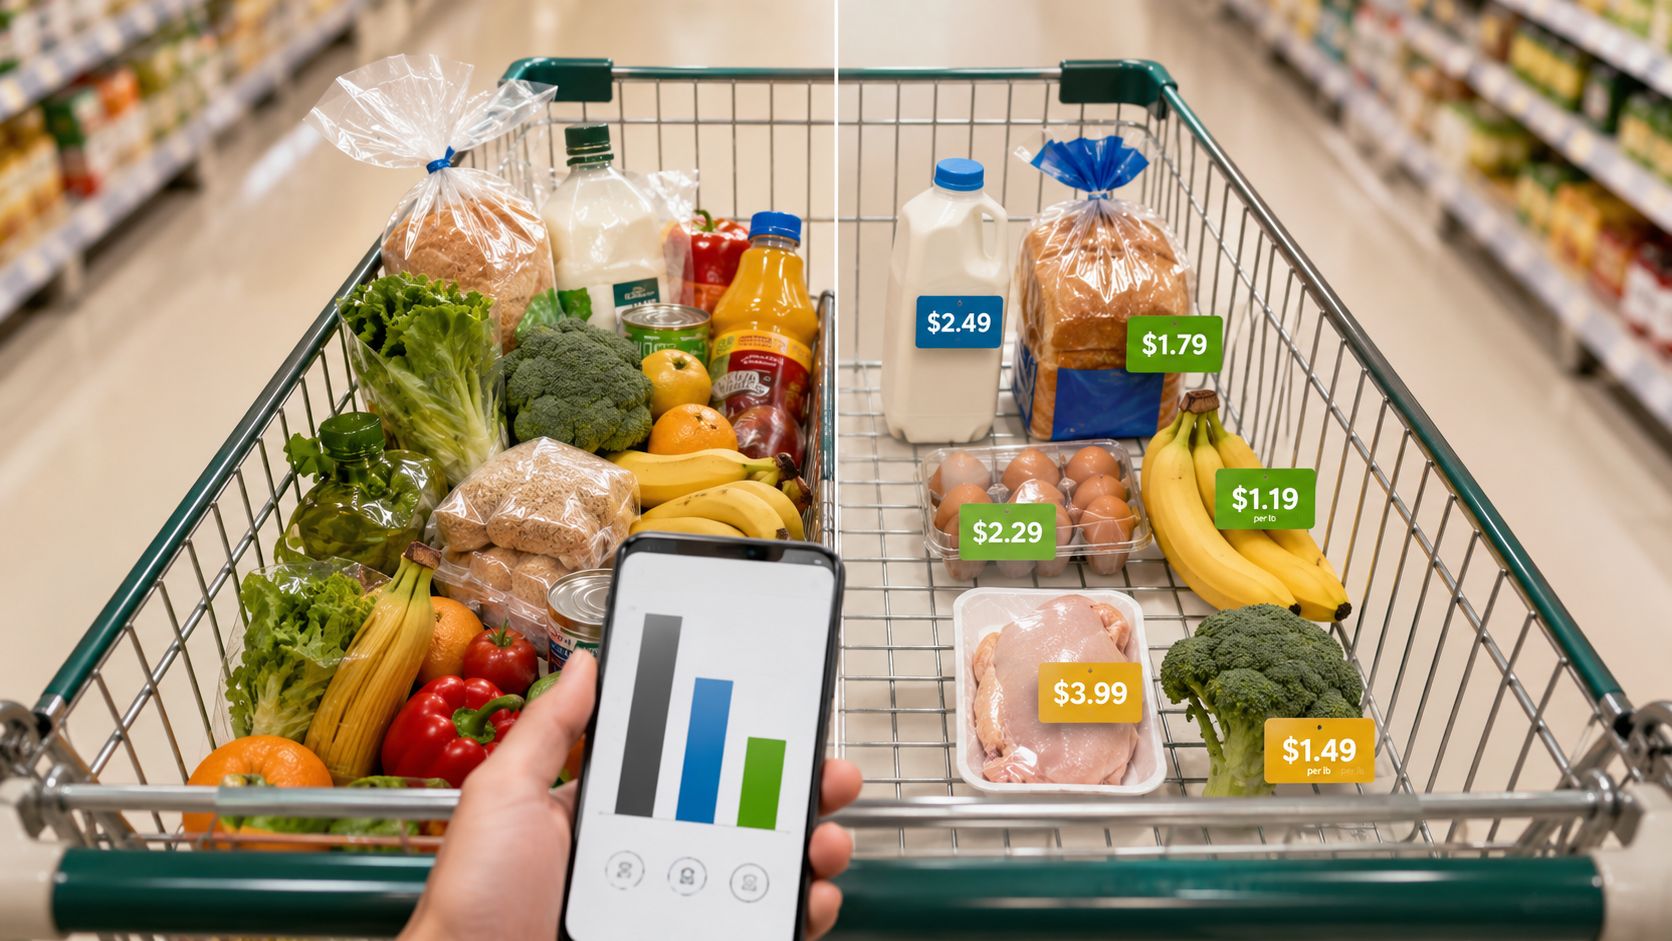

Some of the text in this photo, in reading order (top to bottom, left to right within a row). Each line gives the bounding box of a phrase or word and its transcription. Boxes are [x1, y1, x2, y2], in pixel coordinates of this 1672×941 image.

[927, 310, 991, 335] $2.49
[1142, 331, 1207, 357] $1.79
[1232, 484, 1299, 513] $1.19
[1253, 515, 1268, 524] per
[973, 520, 1043, 545] $2.29
[1054, 679, 1128, 706] $3.99
[1283, 735, 1356, 765] $1.49
[1306, 767, 1322, 777] per
